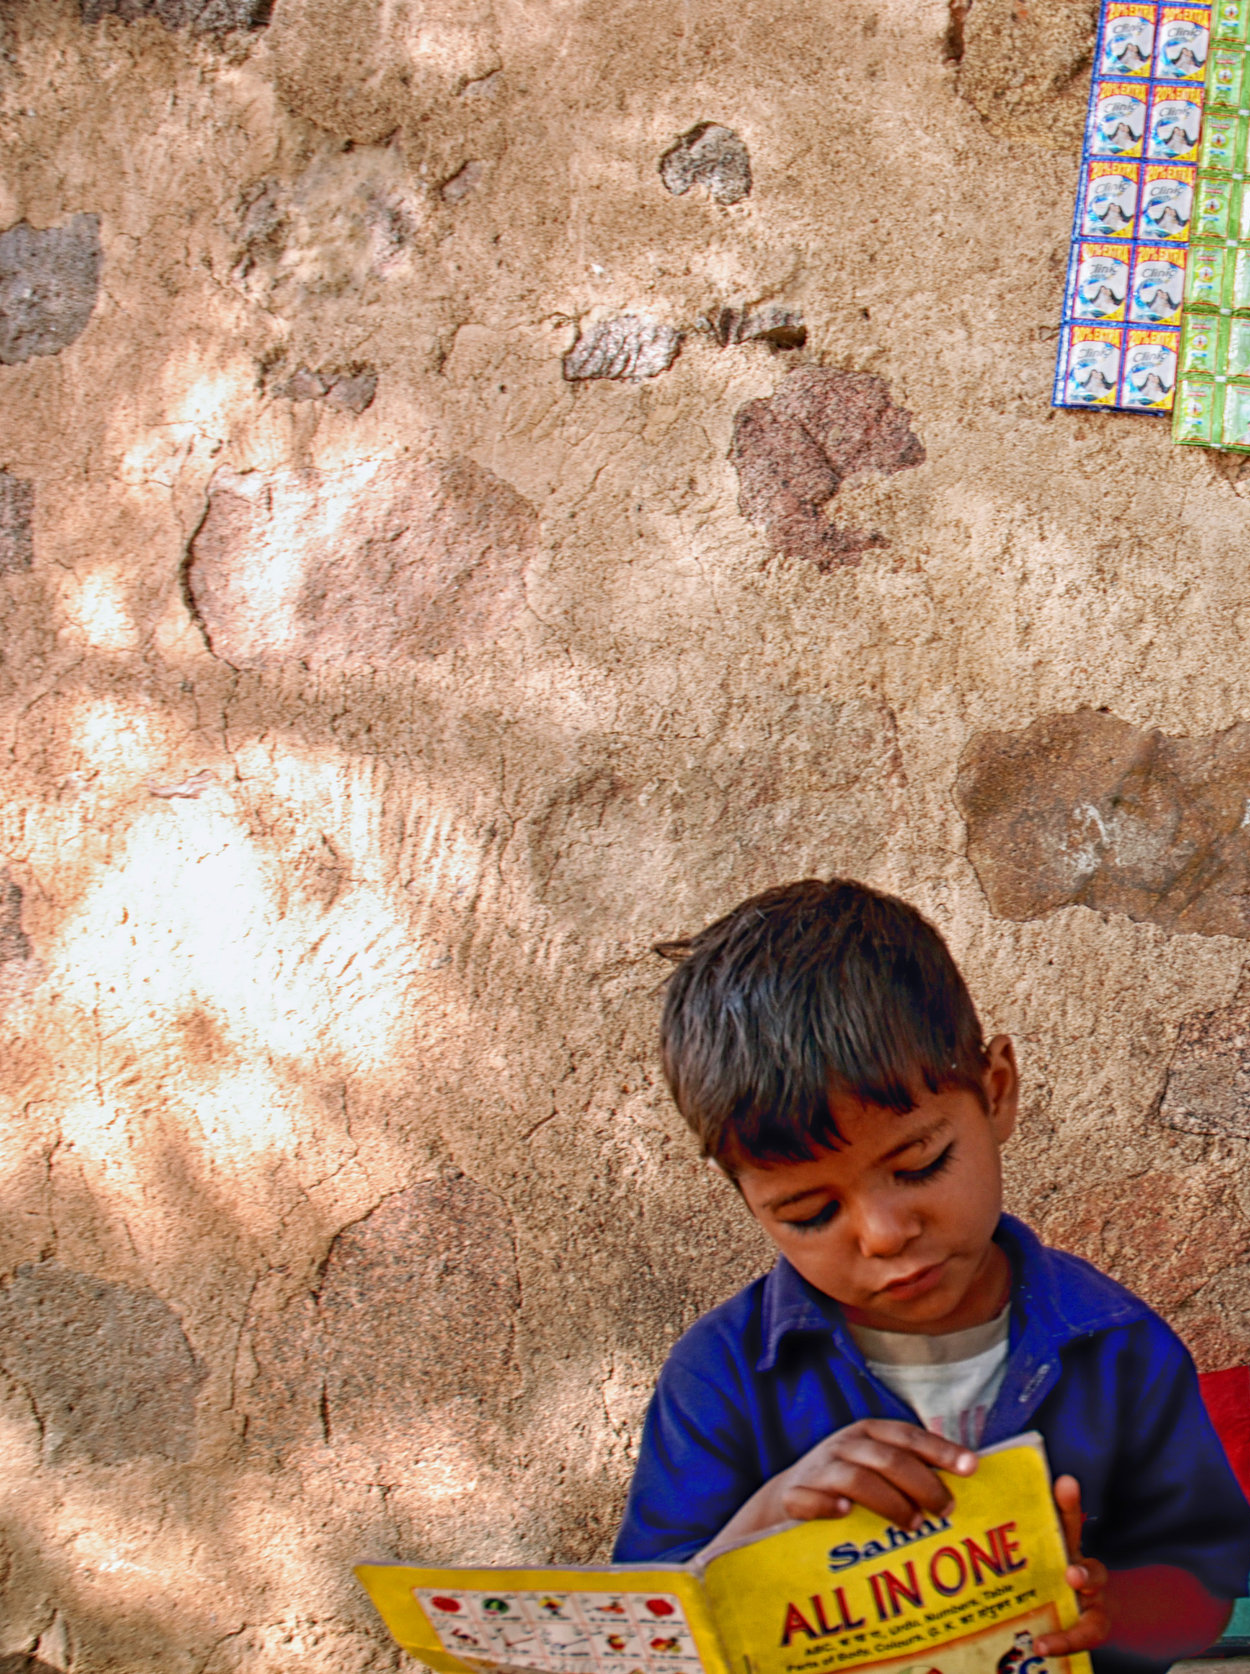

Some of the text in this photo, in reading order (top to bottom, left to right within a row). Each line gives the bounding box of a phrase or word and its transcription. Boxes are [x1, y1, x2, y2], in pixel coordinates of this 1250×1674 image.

[781, 1520, 1028, 1647] ALL IN ONE
